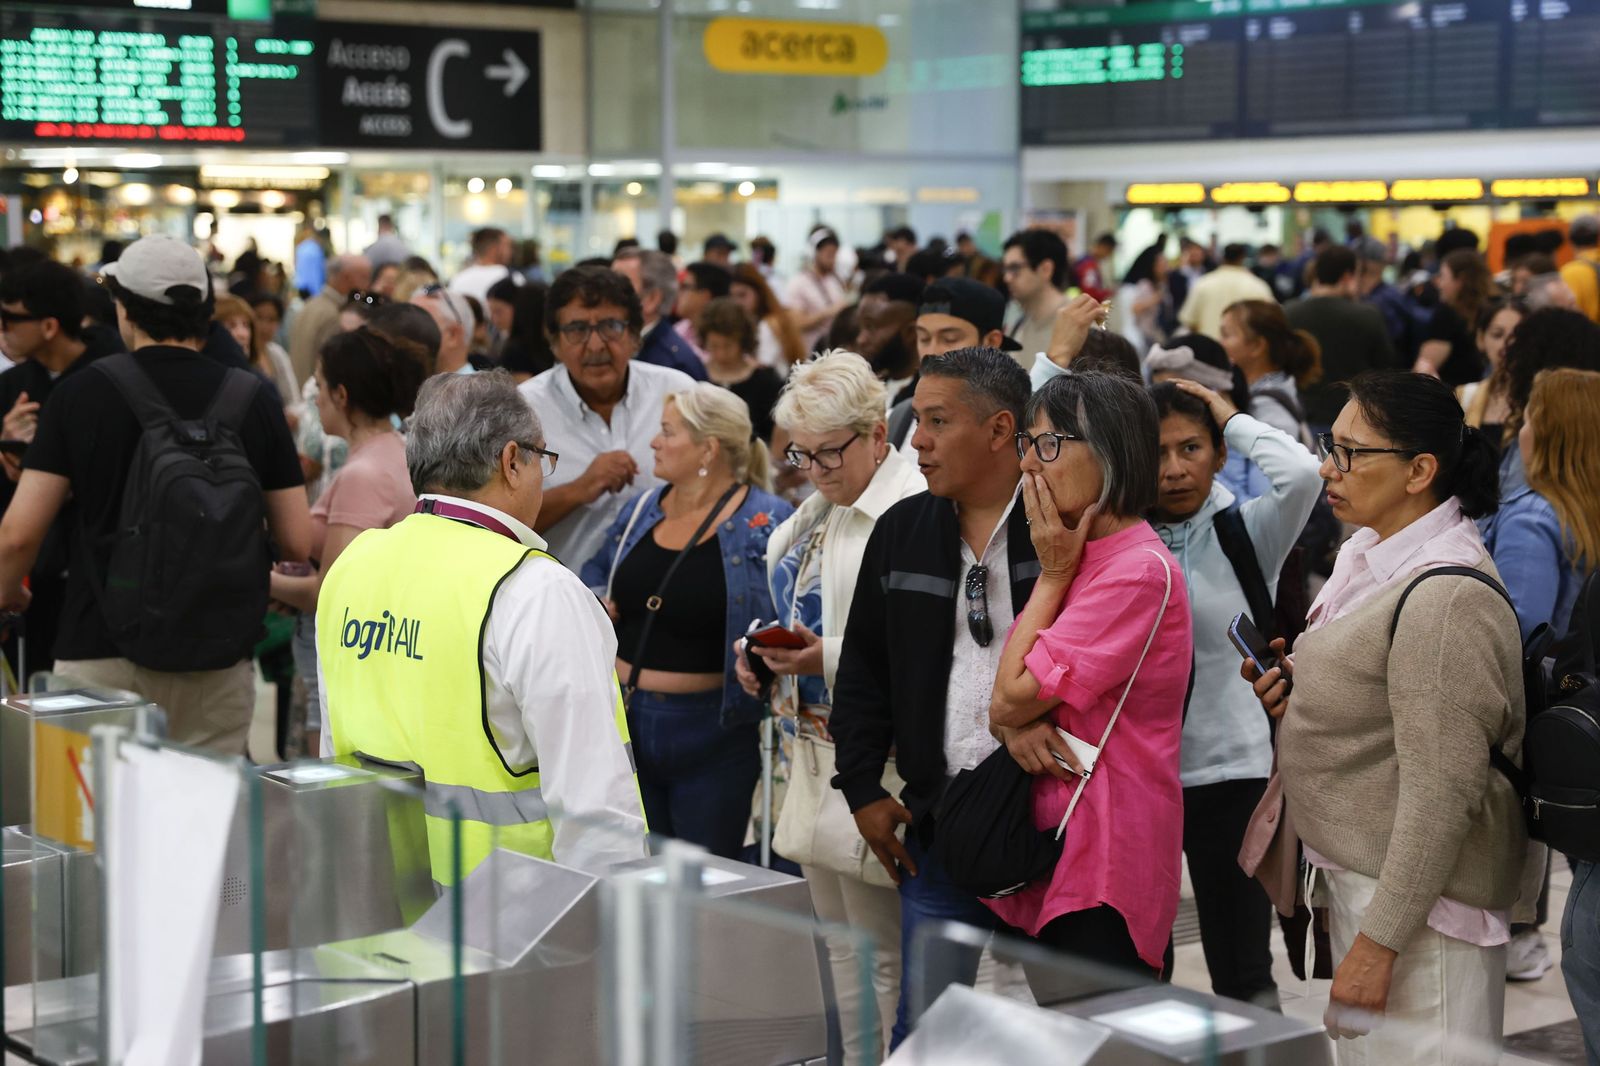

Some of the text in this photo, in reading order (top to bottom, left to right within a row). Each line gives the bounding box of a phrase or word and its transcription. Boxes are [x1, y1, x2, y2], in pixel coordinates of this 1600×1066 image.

[329, 39, 410, 70] Acceso
[741, 31, 856, 64] acerca
[343, 75, 411, 107] Accés
[427, 40, 471, 138] C
